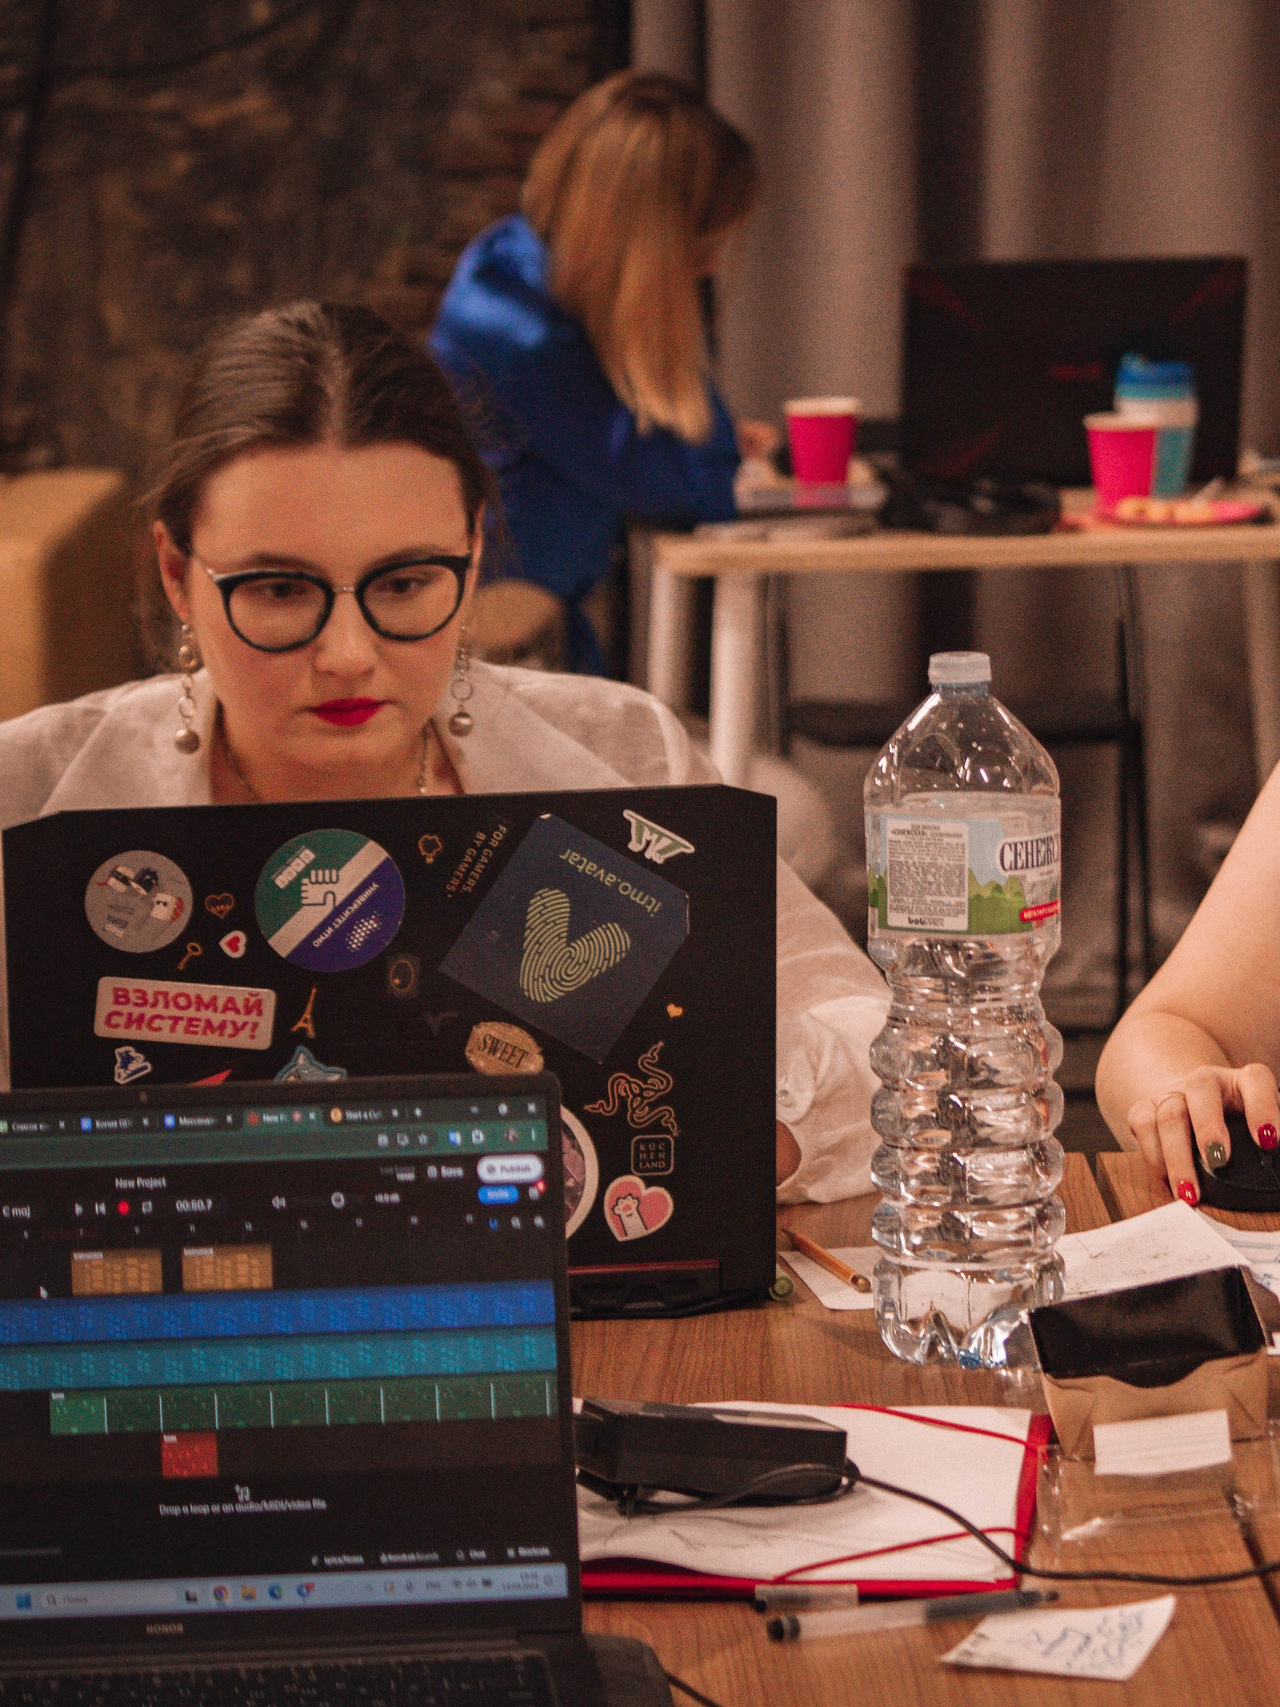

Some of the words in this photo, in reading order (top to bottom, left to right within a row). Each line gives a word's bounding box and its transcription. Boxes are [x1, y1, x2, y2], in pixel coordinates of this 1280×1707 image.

[474, 832, 487, 847] BY
[489, 824, 508, 848] FOR
[559, 849, 662, 918] itmo.avatar
[332, 881, 380, 930] УНИВЕРСИТЕТ
[311, 928, 332, 949] ИТМО
[112, 986, 264, 1018] ВЗЛОМАЙ
[103, 1010, 259, 1041] СИСТЕМУ!
[477, 1033, 532, 1069] SWEET
[115, 1178, 135, 1189] New
[136, 1176, 167, 1190] Project
[159, 1503, 181, 1517] Drop
[190, 1503, 210, 1516] loop
[222, 1504, 235, 1514] an
[312, 1498, 327, 1511] file
[145, 1623, 184, 1635] HONOR
